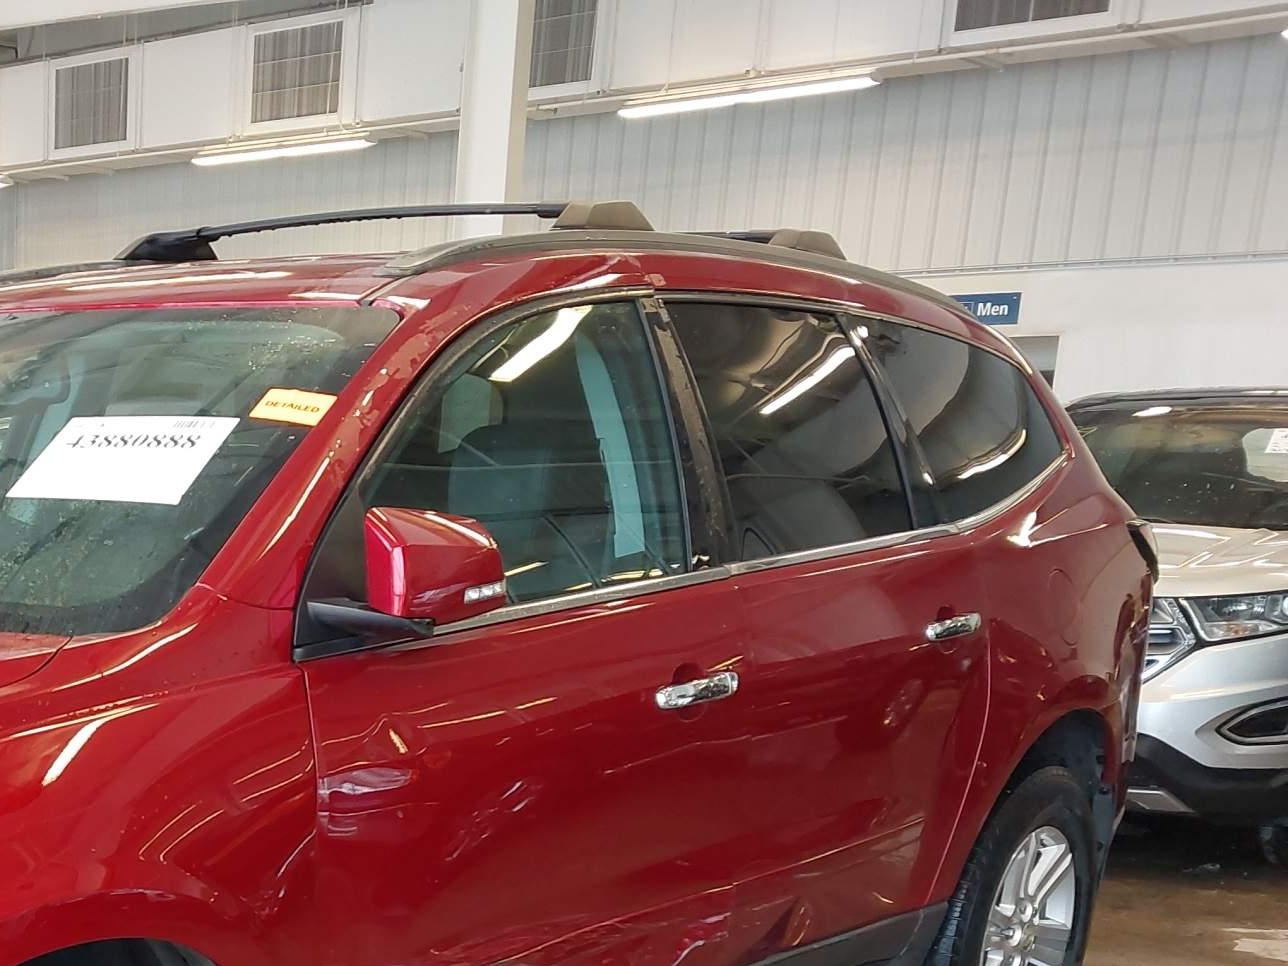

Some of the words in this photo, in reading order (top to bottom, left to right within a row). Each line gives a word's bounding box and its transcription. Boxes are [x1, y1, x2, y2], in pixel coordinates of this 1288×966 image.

[976, 302, 1009, 316] Men
[264, 400, 321, 413] DETAILED
[66, 433, 202, 449] 43880888
